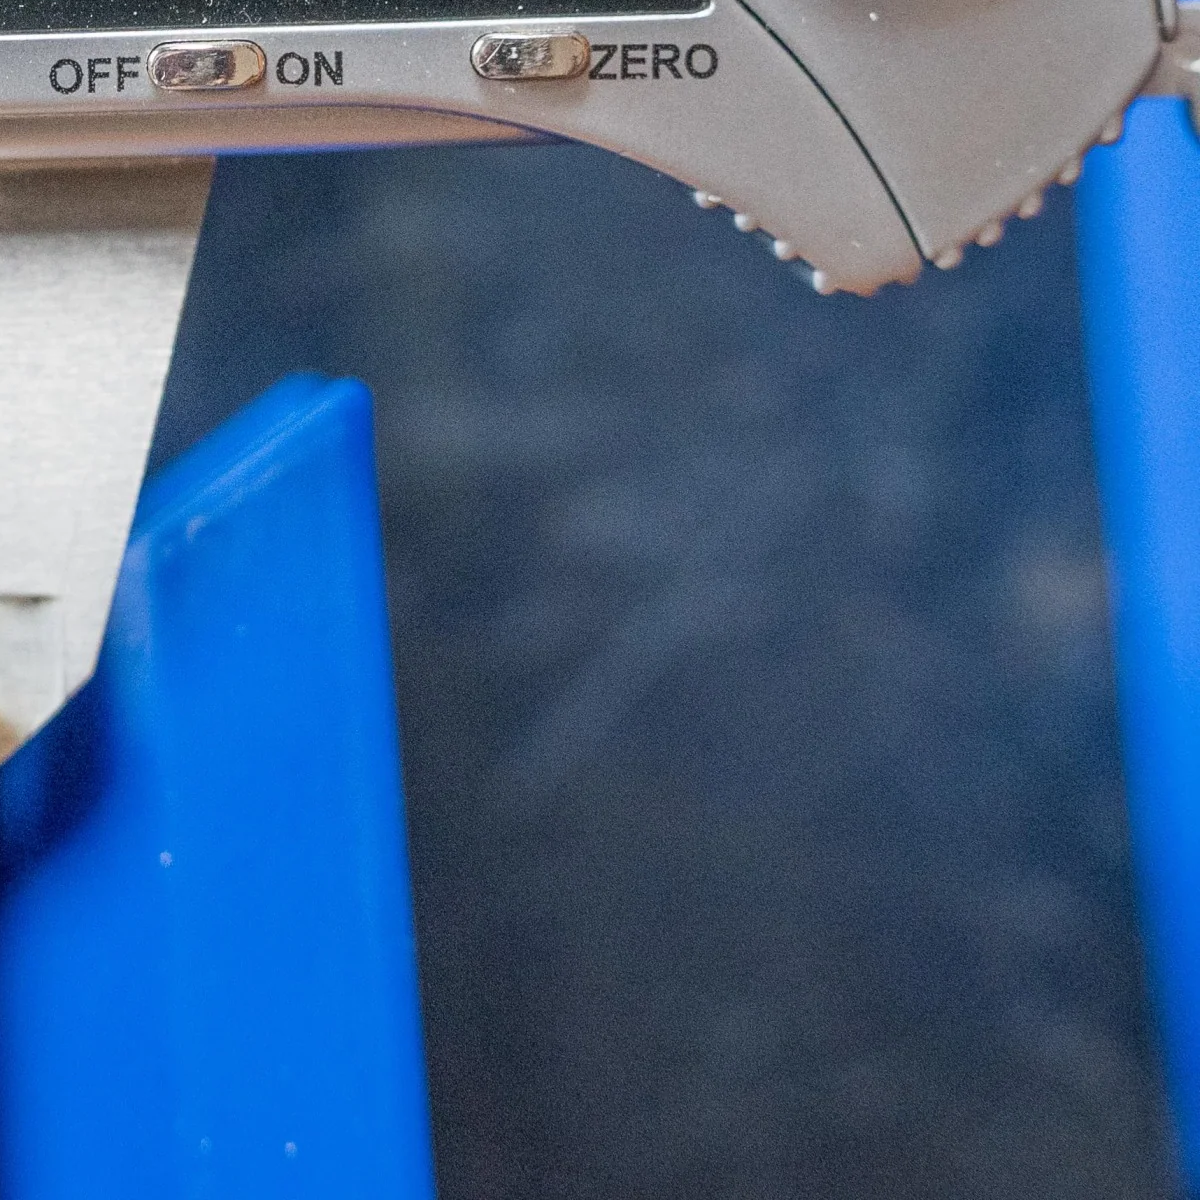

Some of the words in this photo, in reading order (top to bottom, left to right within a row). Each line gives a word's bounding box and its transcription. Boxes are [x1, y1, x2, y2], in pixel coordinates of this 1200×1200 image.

[49, 56, 141, 95] OFF
[275, 50, 345, 88] ON
[587, 43, 719, 82] ZERO
